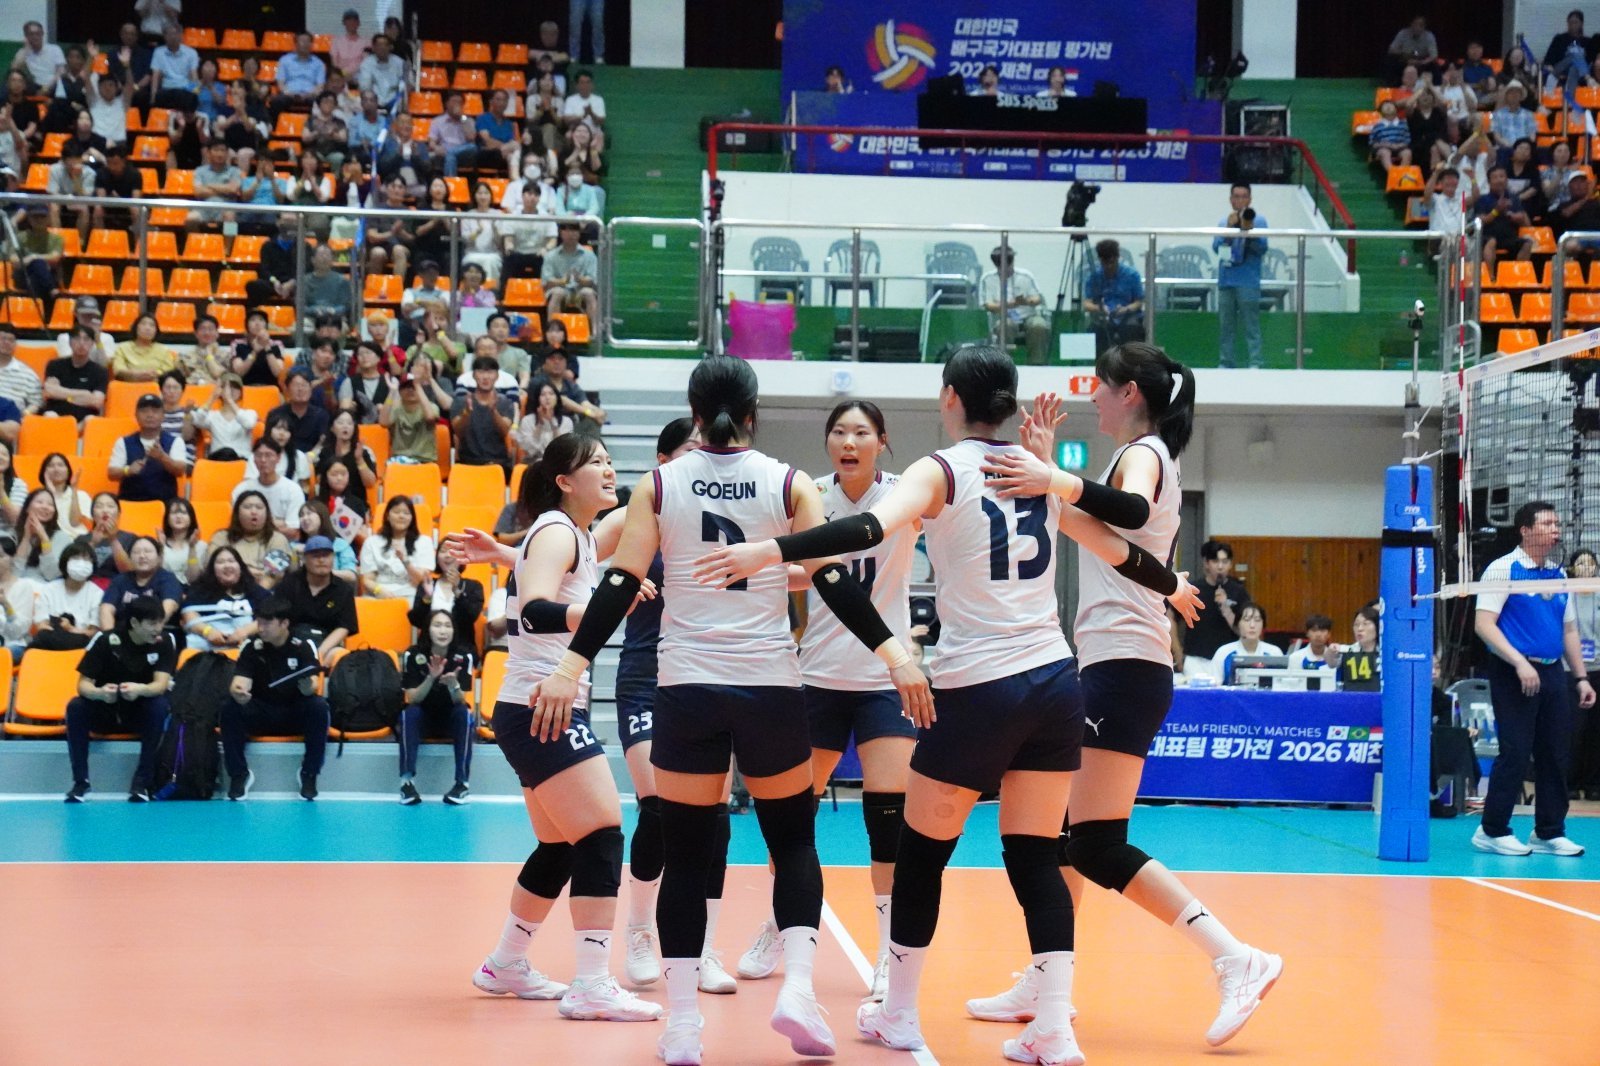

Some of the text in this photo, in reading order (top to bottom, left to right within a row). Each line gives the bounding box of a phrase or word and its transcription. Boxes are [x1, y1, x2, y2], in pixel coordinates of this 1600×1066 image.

[954, 17, 1019, 36] 대한민국
[999, 62, 1032, 80] 제천
[691, 479, 756, 500] GOEUN
[981, 493, 1052, 581] 13
[1346, 655, 1372, 680] 14
[628, 711, 652, 736] 23
[1165, 723, 1322, 738] TEAM FRIENDLY MATCHES
[564, 724, 595, 751] 22
[1211, 737, 1274, 760] 평가전
[1278, 741, 1342, 762] 2026
